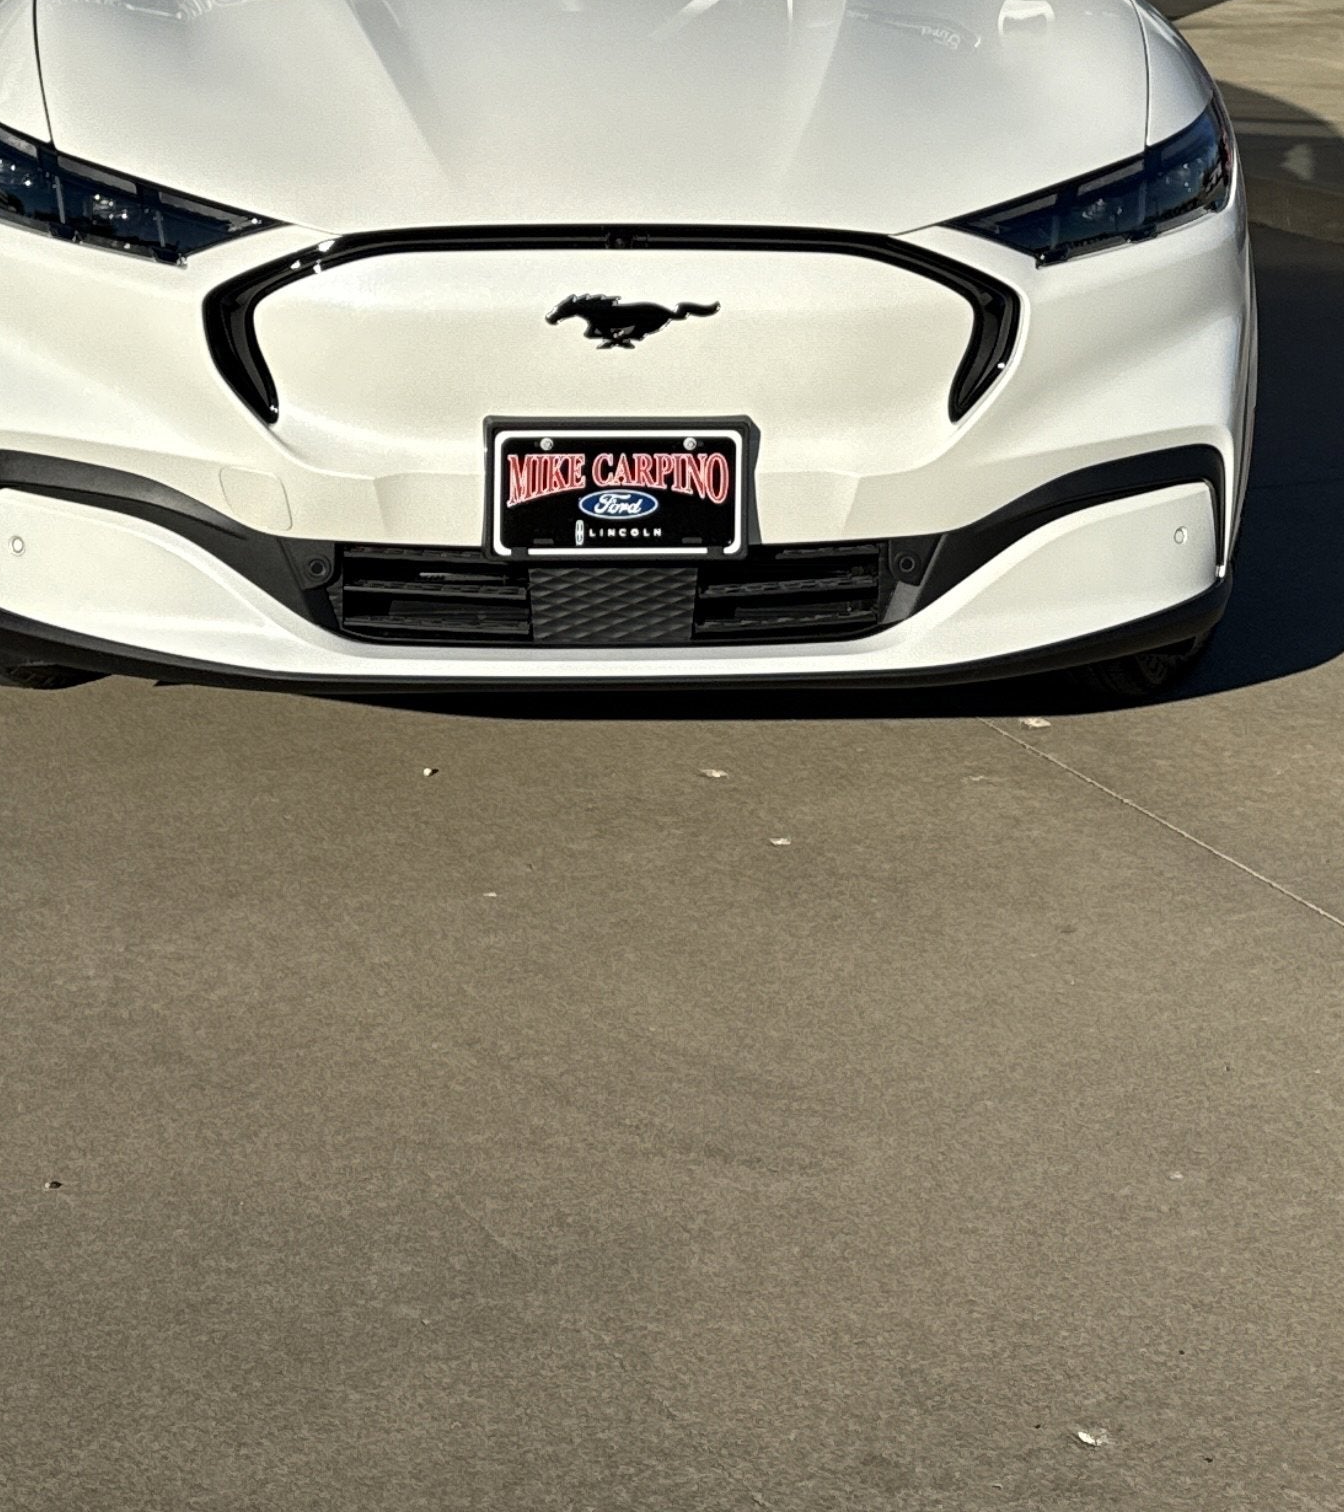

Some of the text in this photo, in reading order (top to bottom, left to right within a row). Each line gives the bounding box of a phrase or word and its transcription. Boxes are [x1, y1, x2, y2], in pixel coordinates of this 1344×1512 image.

[506, 452, 729, 508] MIKE CARPINO
[594, 494, 642, 515] Ford
[588, 528, 662, 537] LINCOLN
